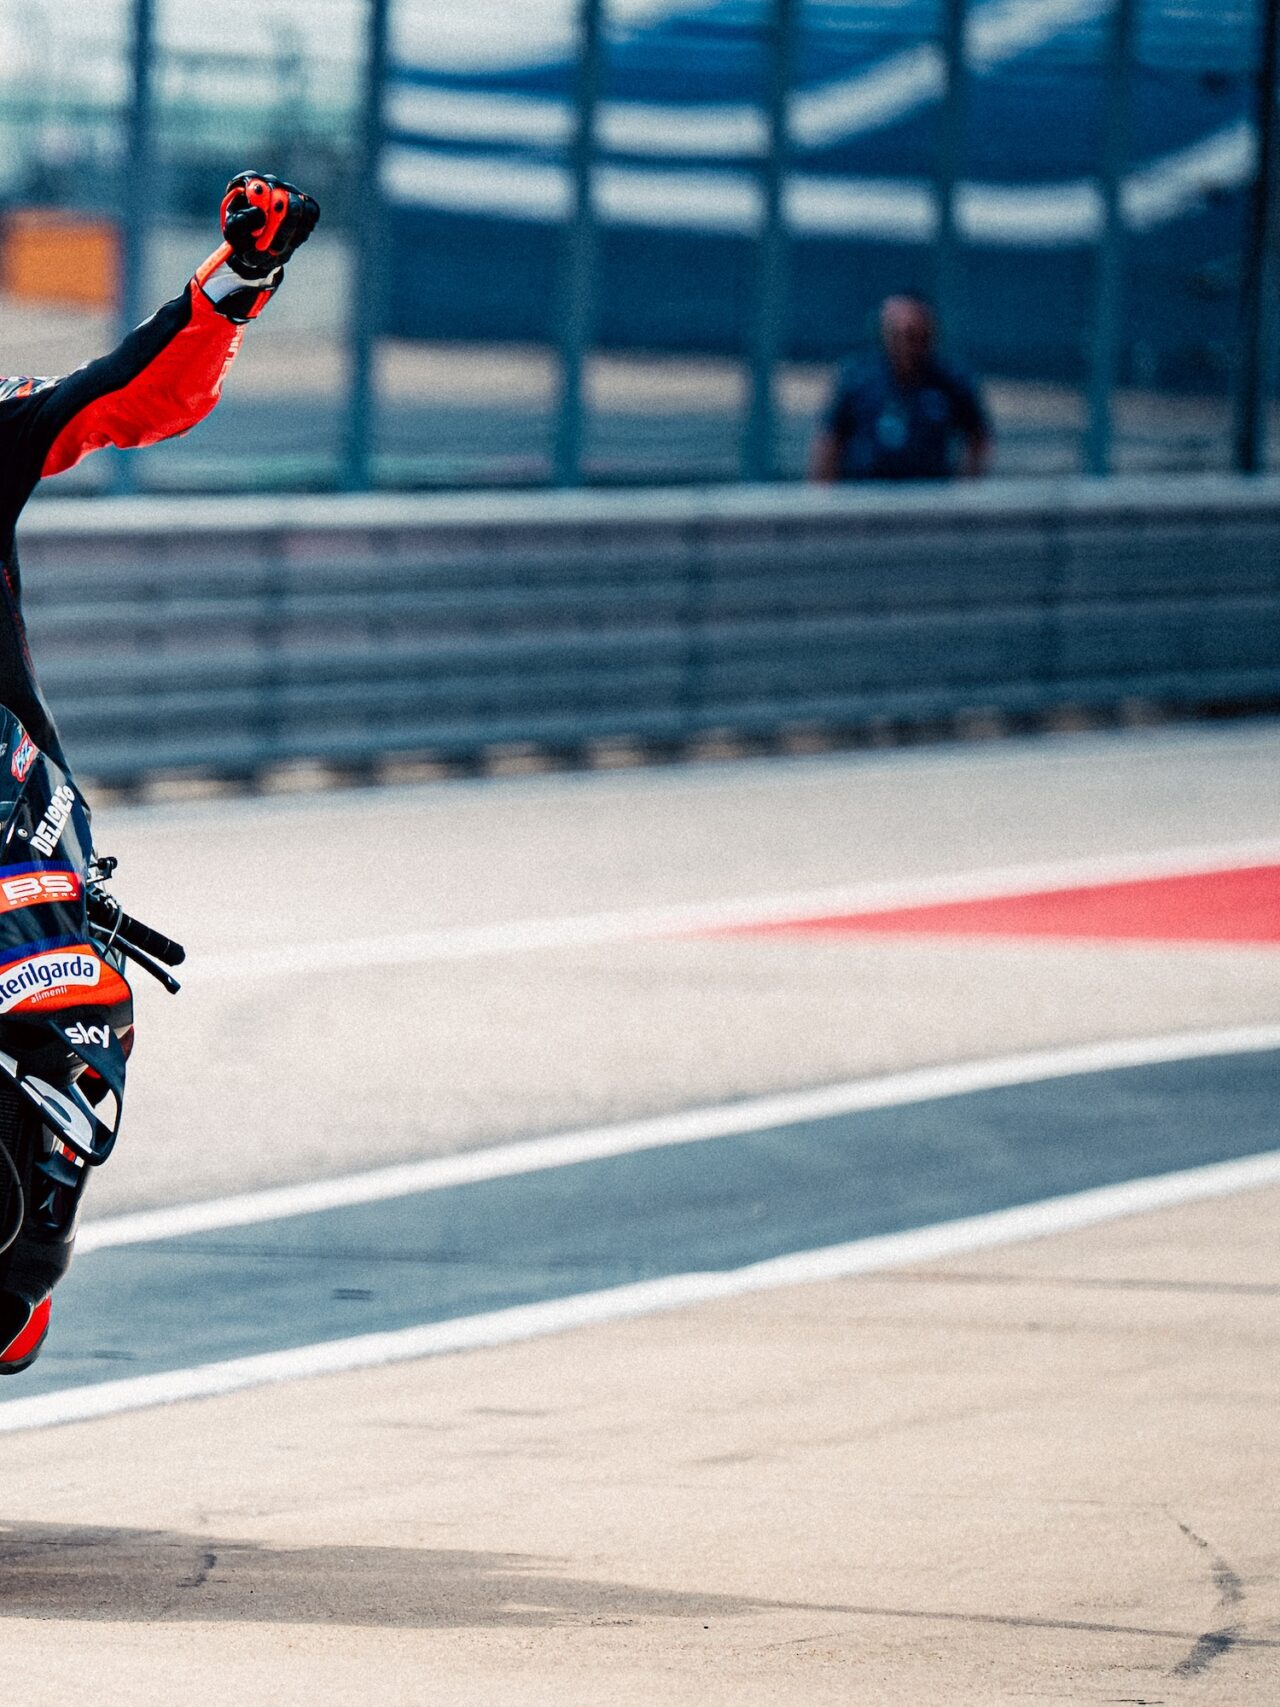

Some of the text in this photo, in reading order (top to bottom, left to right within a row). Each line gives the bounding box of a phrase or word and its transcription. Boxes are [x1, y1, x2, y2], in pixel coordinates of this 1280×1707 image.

[30, 785, 75, 857] DELLORTO
[2, 876, 73, 901] BS
[31, 985, 68, 1004] alimenti
[65, 1021, 110, 1049] sky
